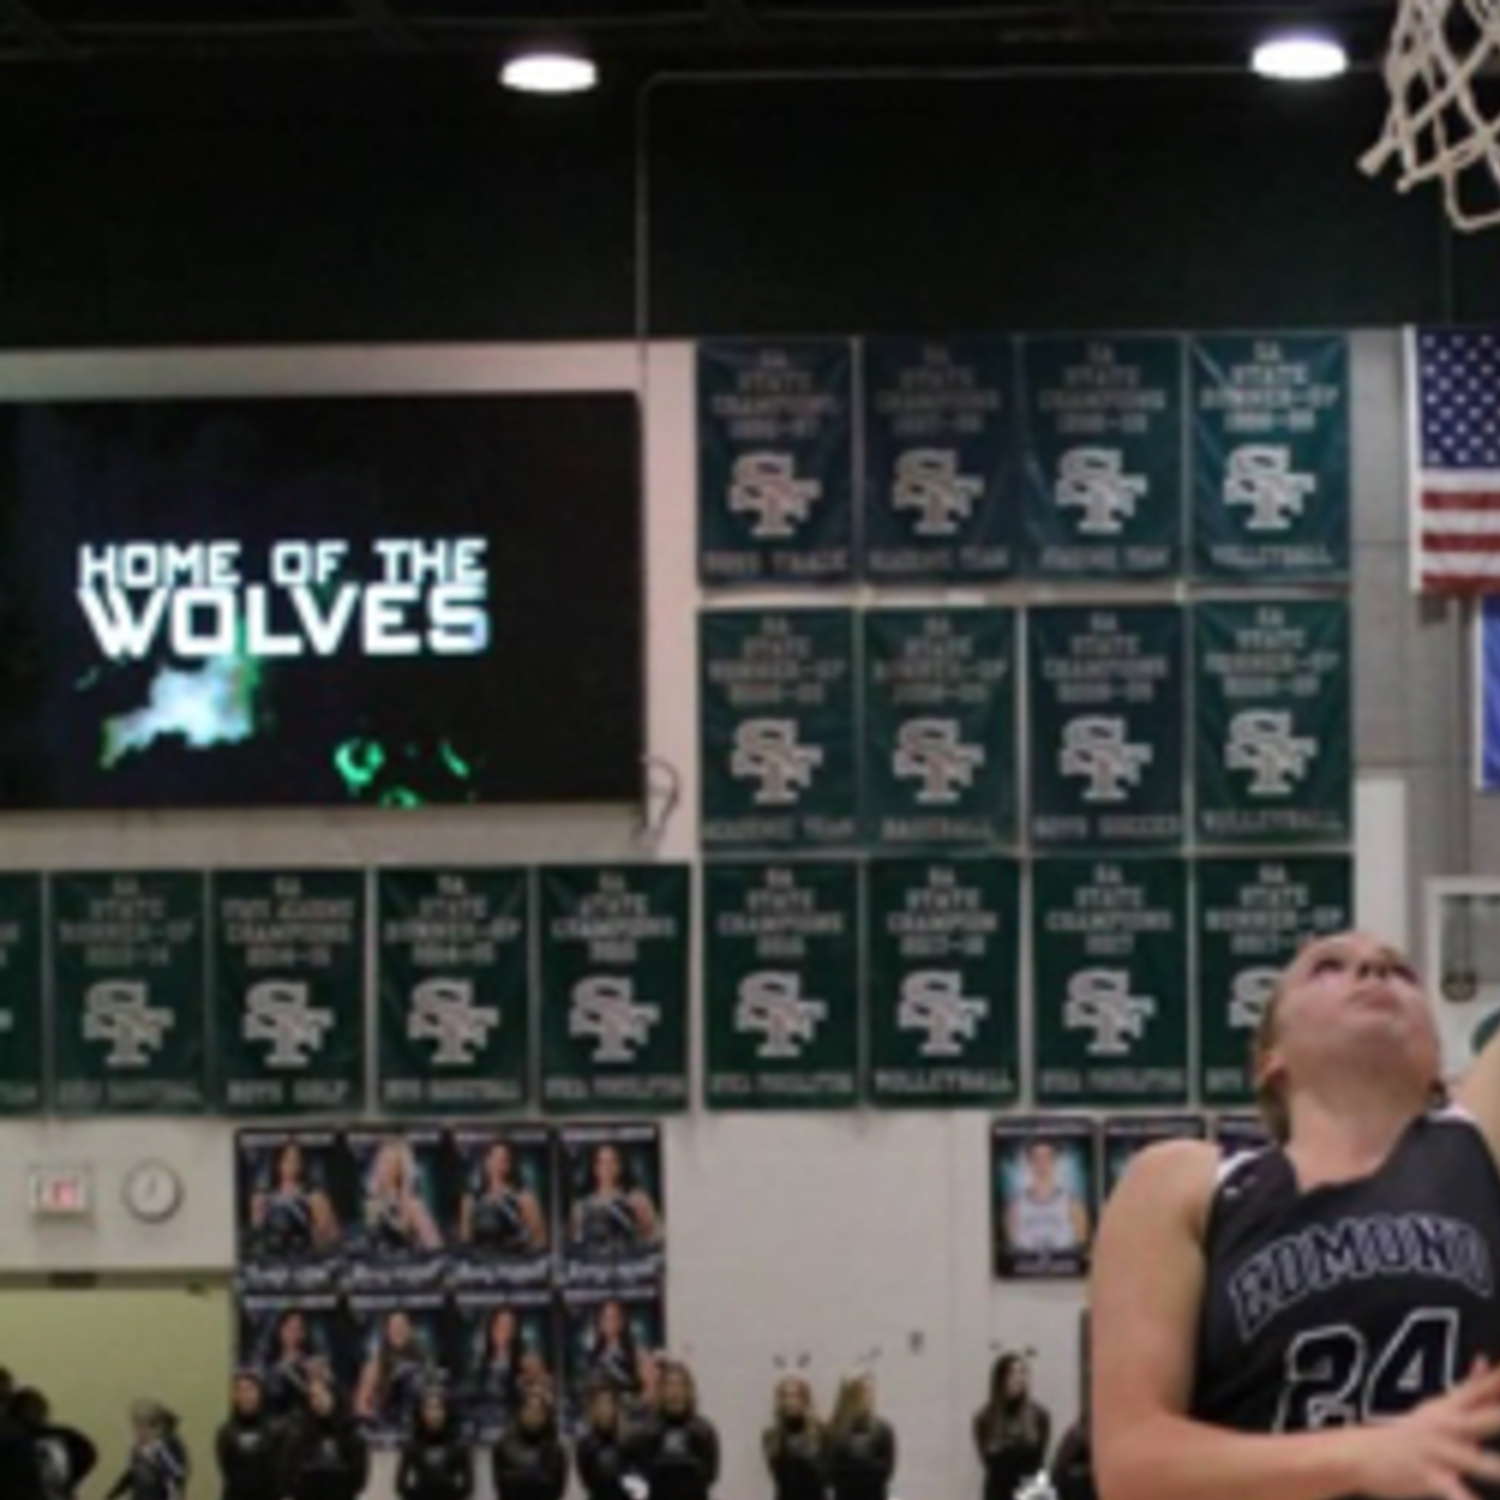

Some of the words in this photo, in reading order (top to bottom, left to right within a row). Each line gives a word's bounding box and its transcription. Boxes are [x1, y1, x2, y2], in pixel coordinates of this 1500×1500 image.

[78, 542, 241, 587] HOME
[271, 541, 348, 585] OF
[374, 539, 488, 584] THE
[78, 584, 489, 658] WOLVES
[1272, 1306, 1459, 1435] 24
